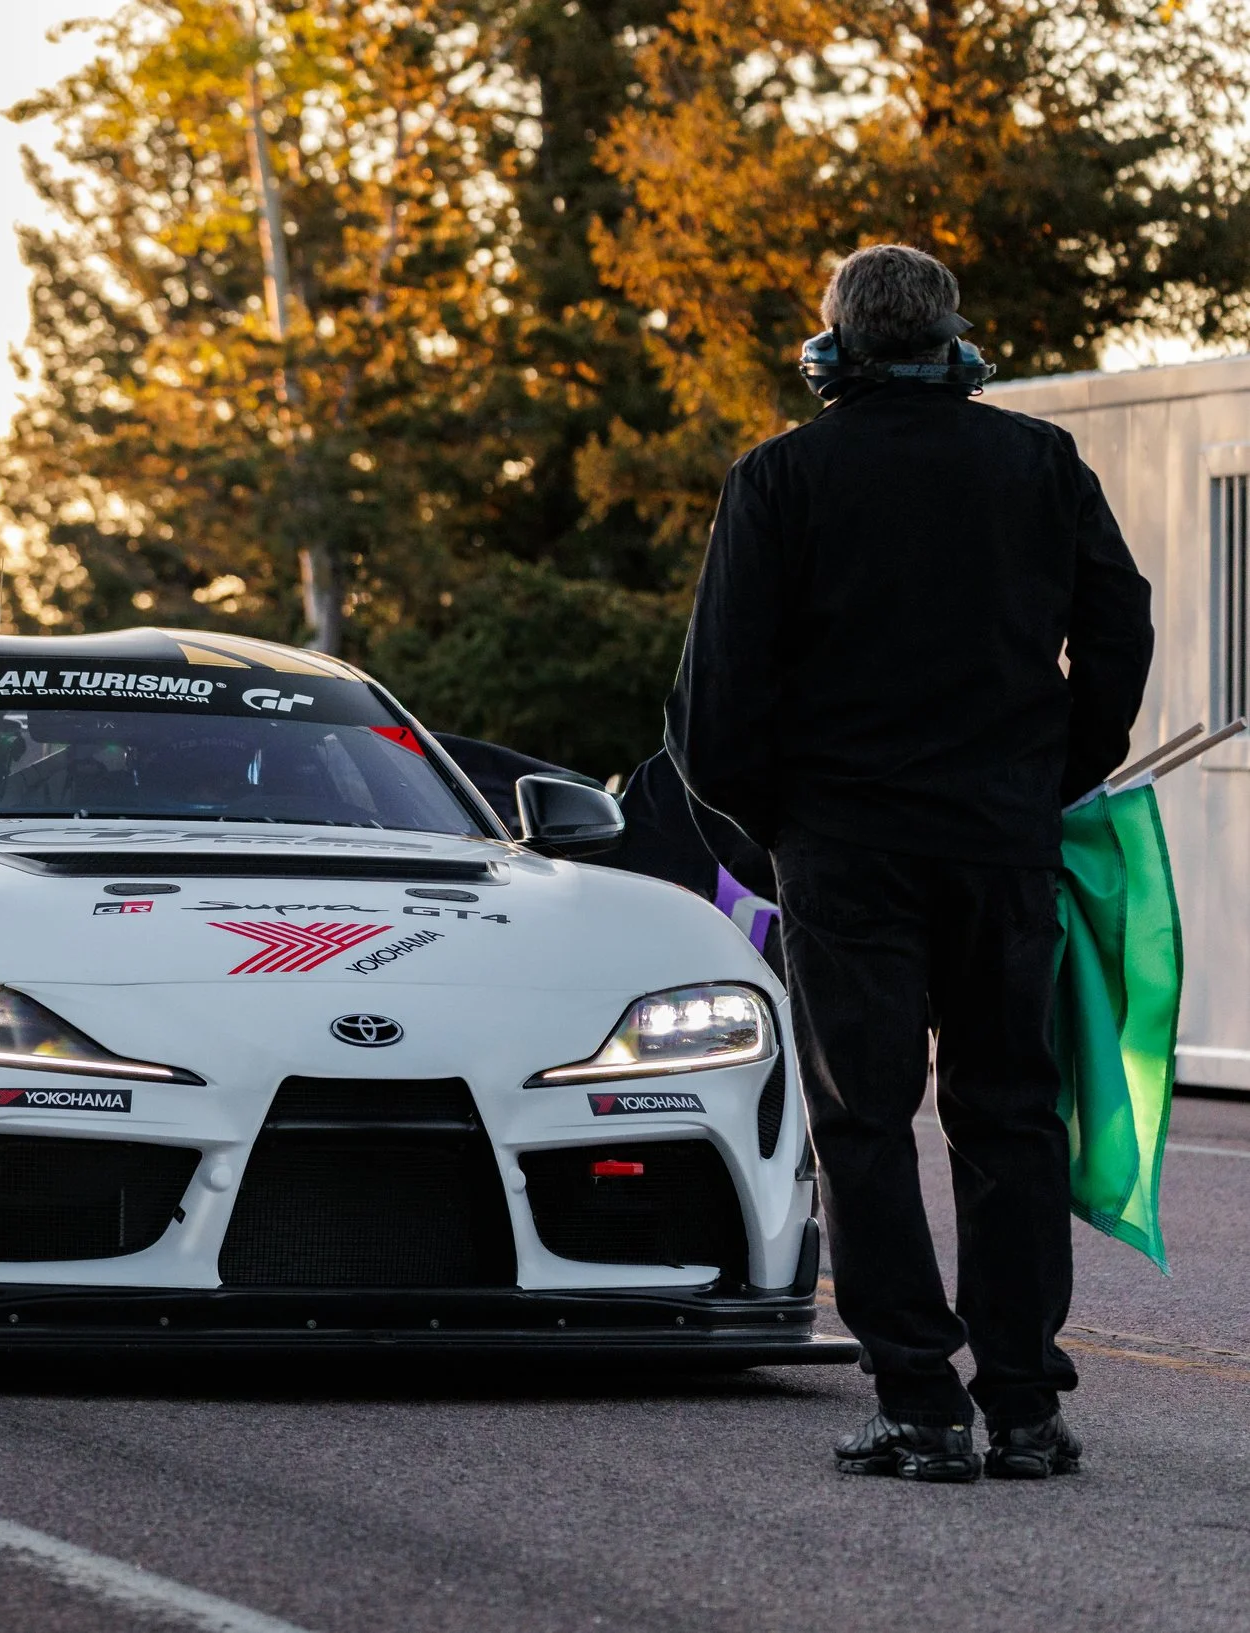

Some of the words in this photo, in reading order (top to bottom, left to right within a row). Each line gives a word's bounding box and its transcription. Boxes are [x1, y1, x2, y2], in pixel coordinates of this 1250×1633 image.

[36, 688, 107, 696] DRIVING
[111, 690, 210, 703] SIMULATOR
[180, 900, 389, 916] Supra
[402, 905, 511, 924] GT4
[345, 929, 445, 975] YOKOHAMA
[25, 1091, 125, 1108] YOKOHAMA
[617, 1096, 700, 1110] YOKOHAMA
